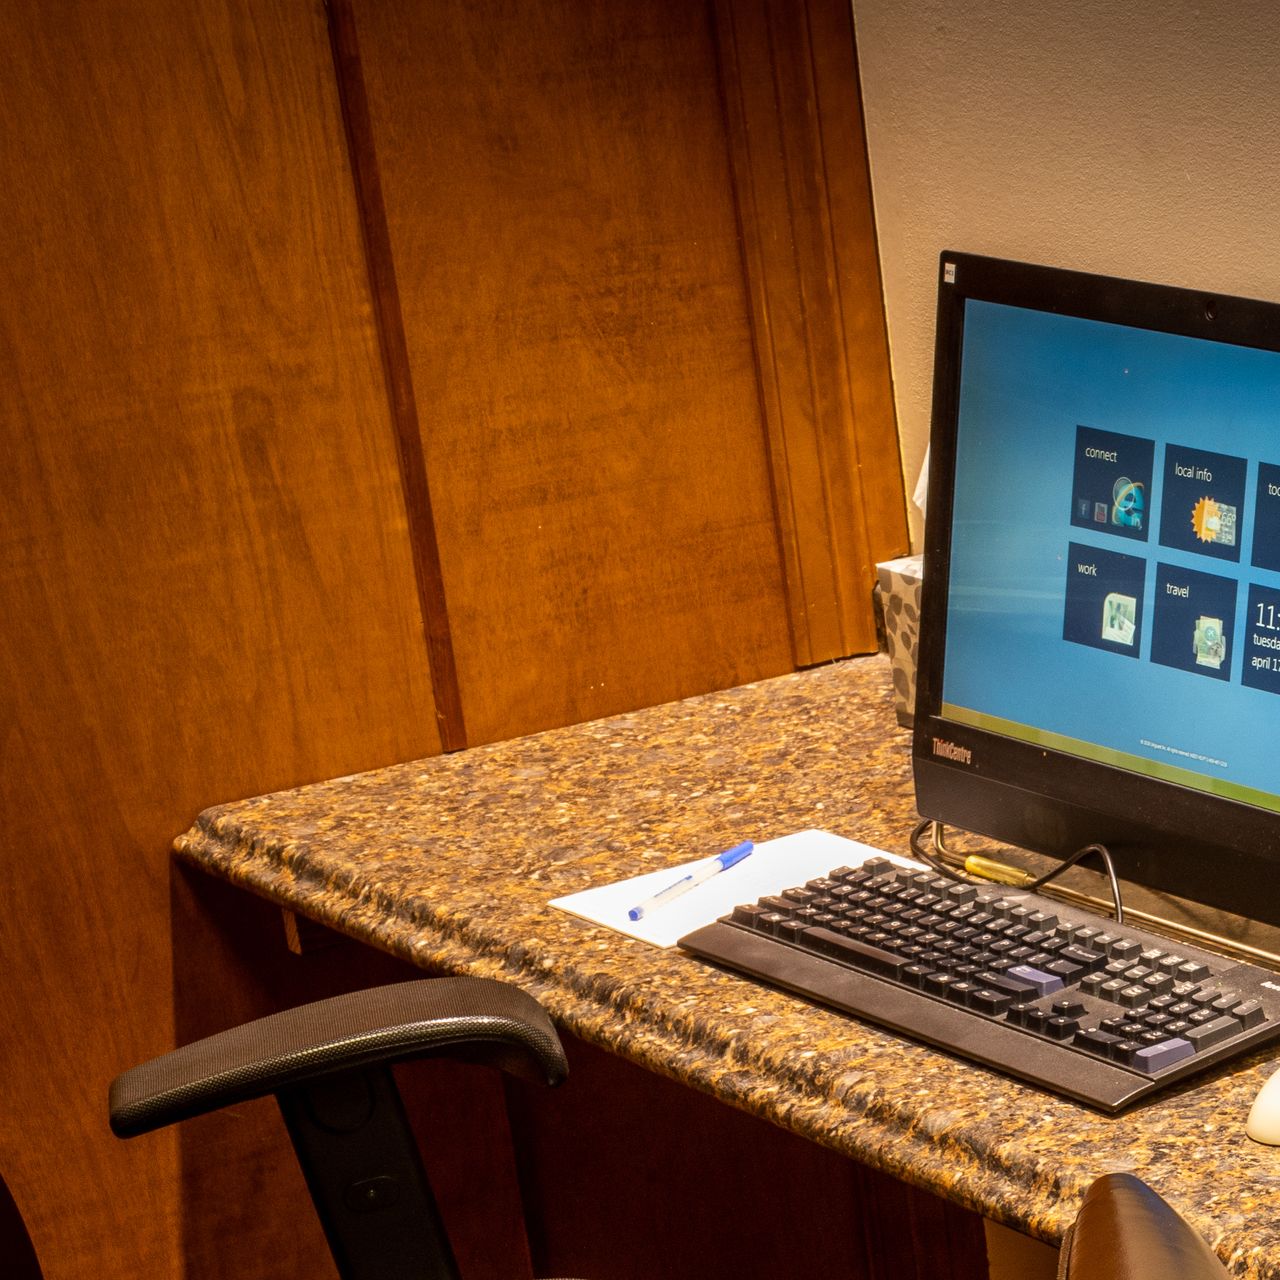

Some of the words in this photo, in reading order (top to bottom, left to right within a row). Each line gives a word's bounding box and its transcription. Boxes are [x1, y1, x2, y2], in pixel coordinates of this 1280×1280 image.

[1085, 447, 1117, 462] connect
[1175, 463, 1194, 478] local
[1196, 466, 1212, 482] info
[1078, 562, 1097, 576] work
[1166, 583, 1189, 598] travel
[1252, 656, 1271, 671] april
[932, 738, 972, 765] ThinkCentre
